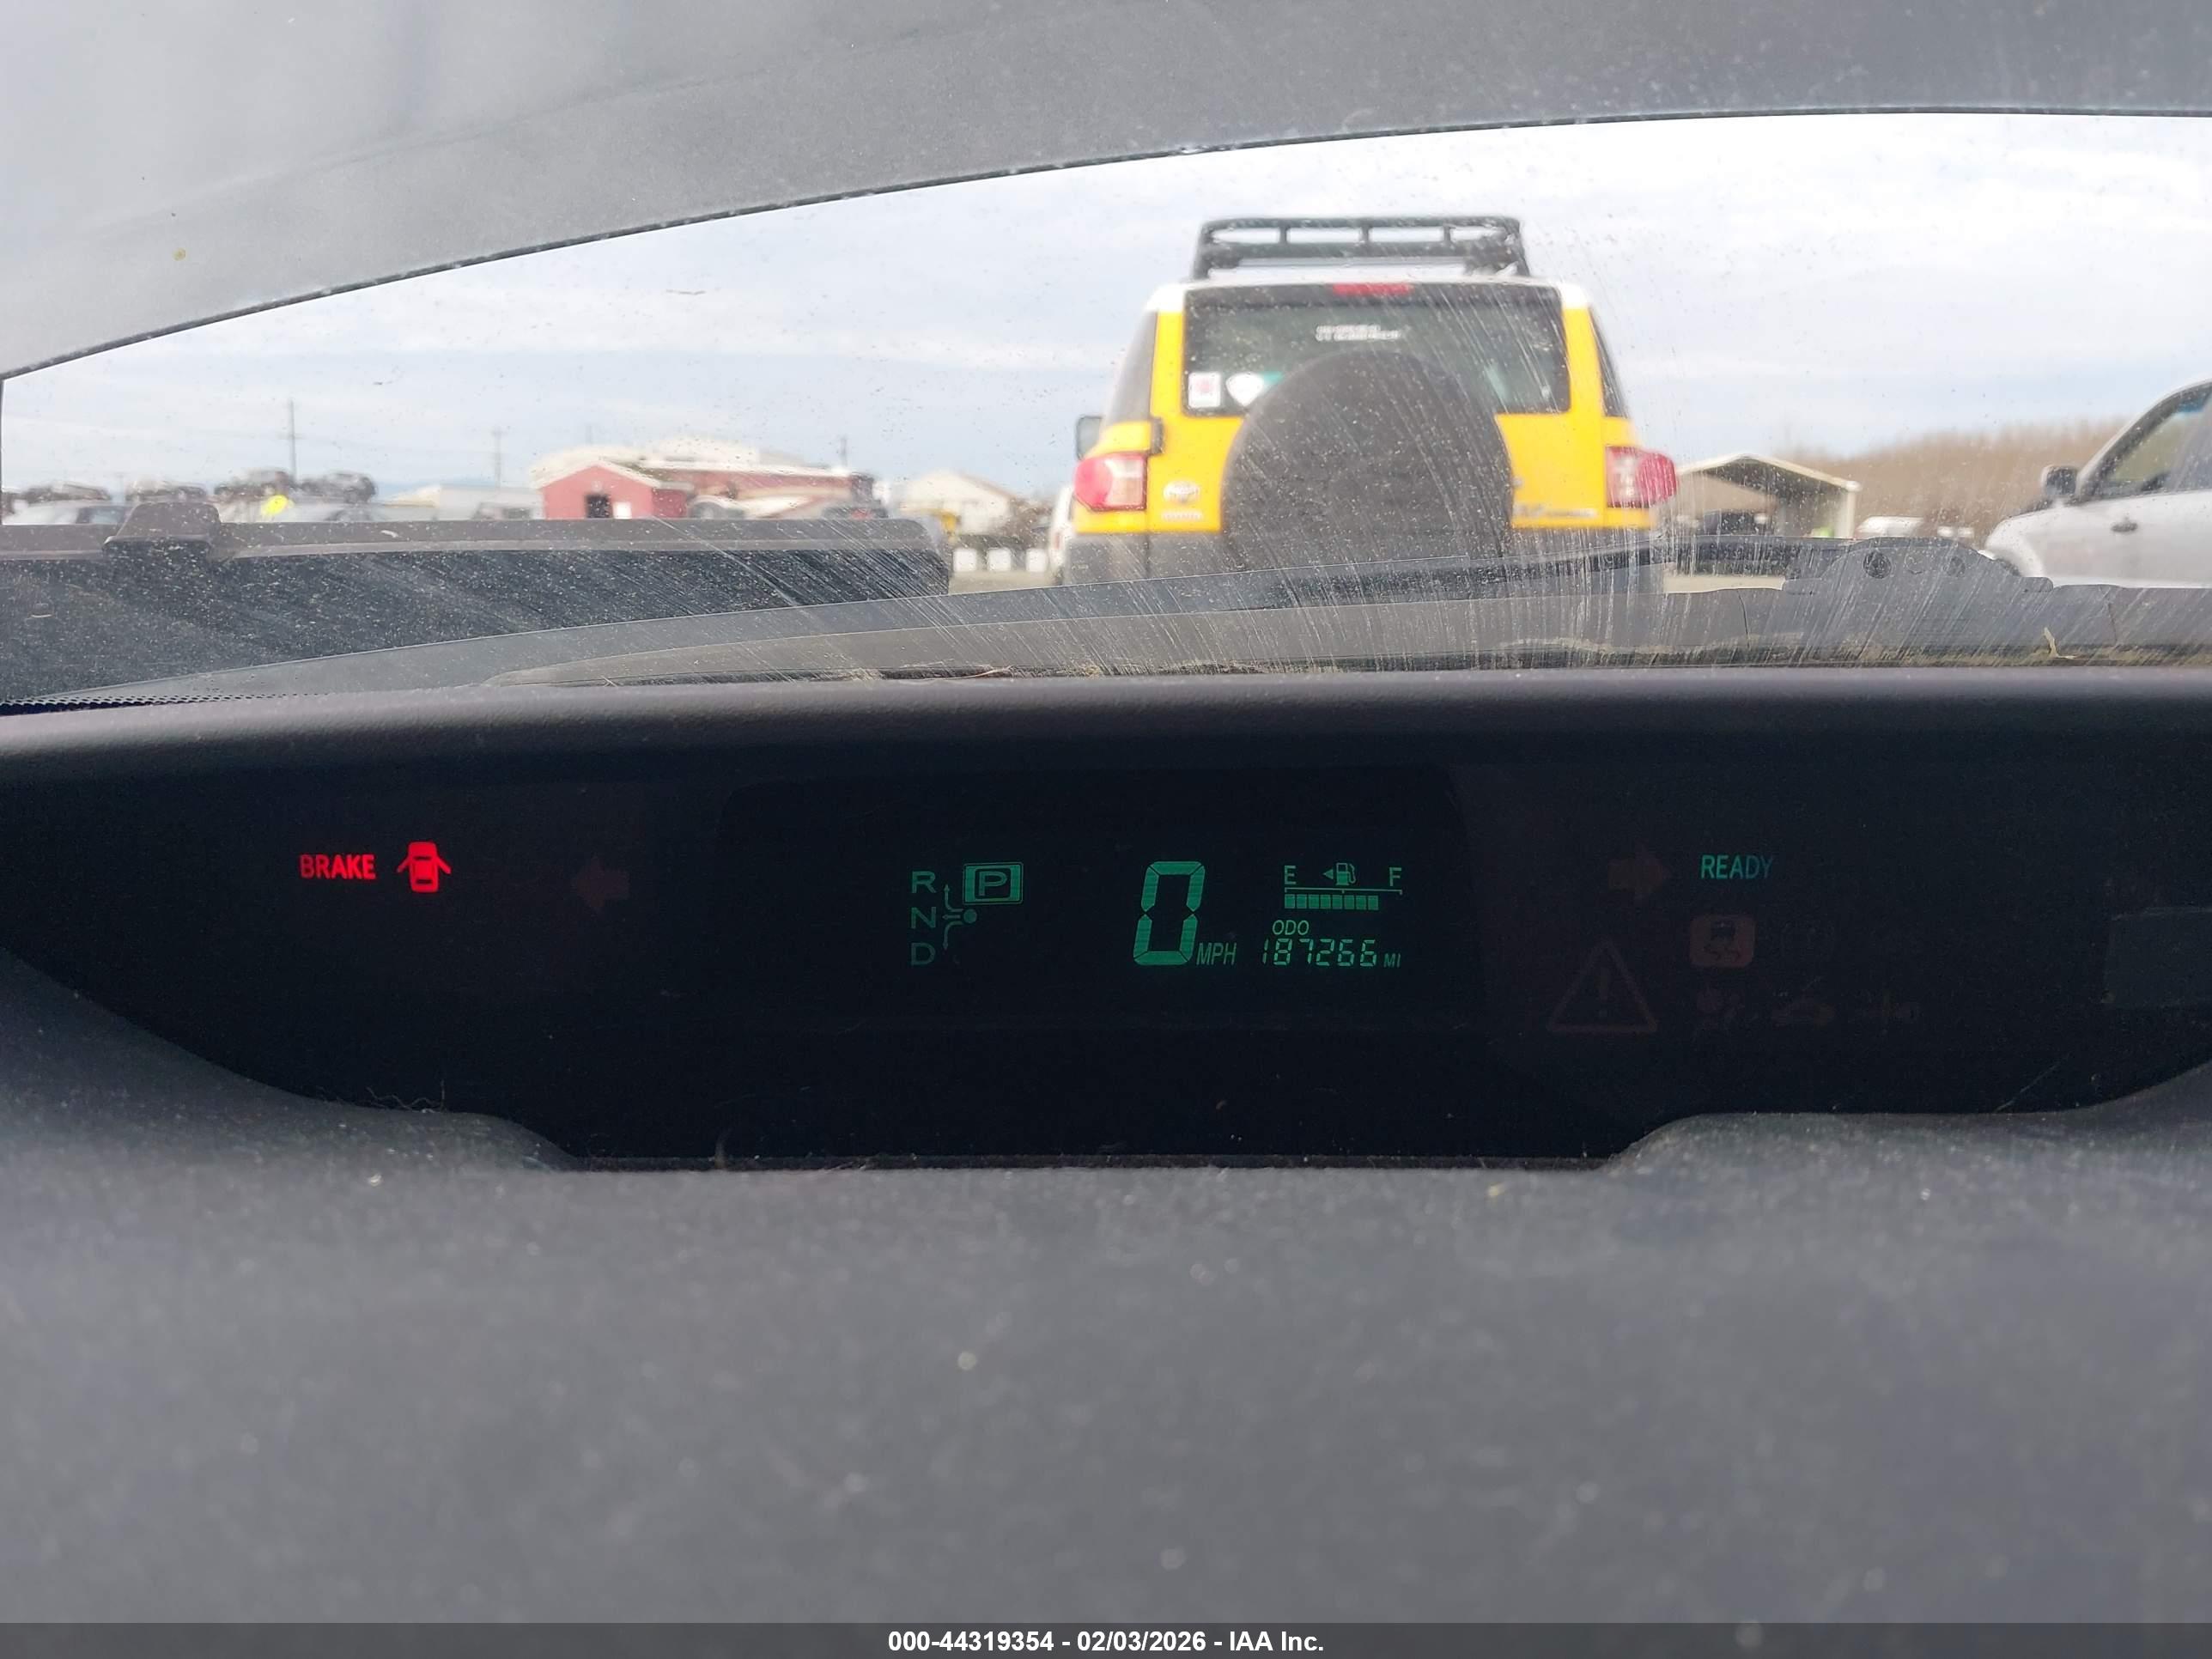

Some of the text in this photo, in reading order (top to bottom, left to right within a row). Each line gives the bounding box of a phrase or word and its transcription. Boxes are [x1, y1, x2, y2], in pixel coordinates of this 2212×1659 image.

[301, 854, 376, 880] BRAKE
[1284, 865, 1402, 886] E F
[1700, 854, 1772, 879] READY
[911, 870, 937, 893] R
[978, 871, 1008, 896] P
[911, 906, 936, 929] N
[1133, 861, 1237, 966] 0 MPH
[1272, 919, 1310, 936] ODO
[911, 941, 936, 966] D
[1262, 937, 1401, 968] 187266 MI
